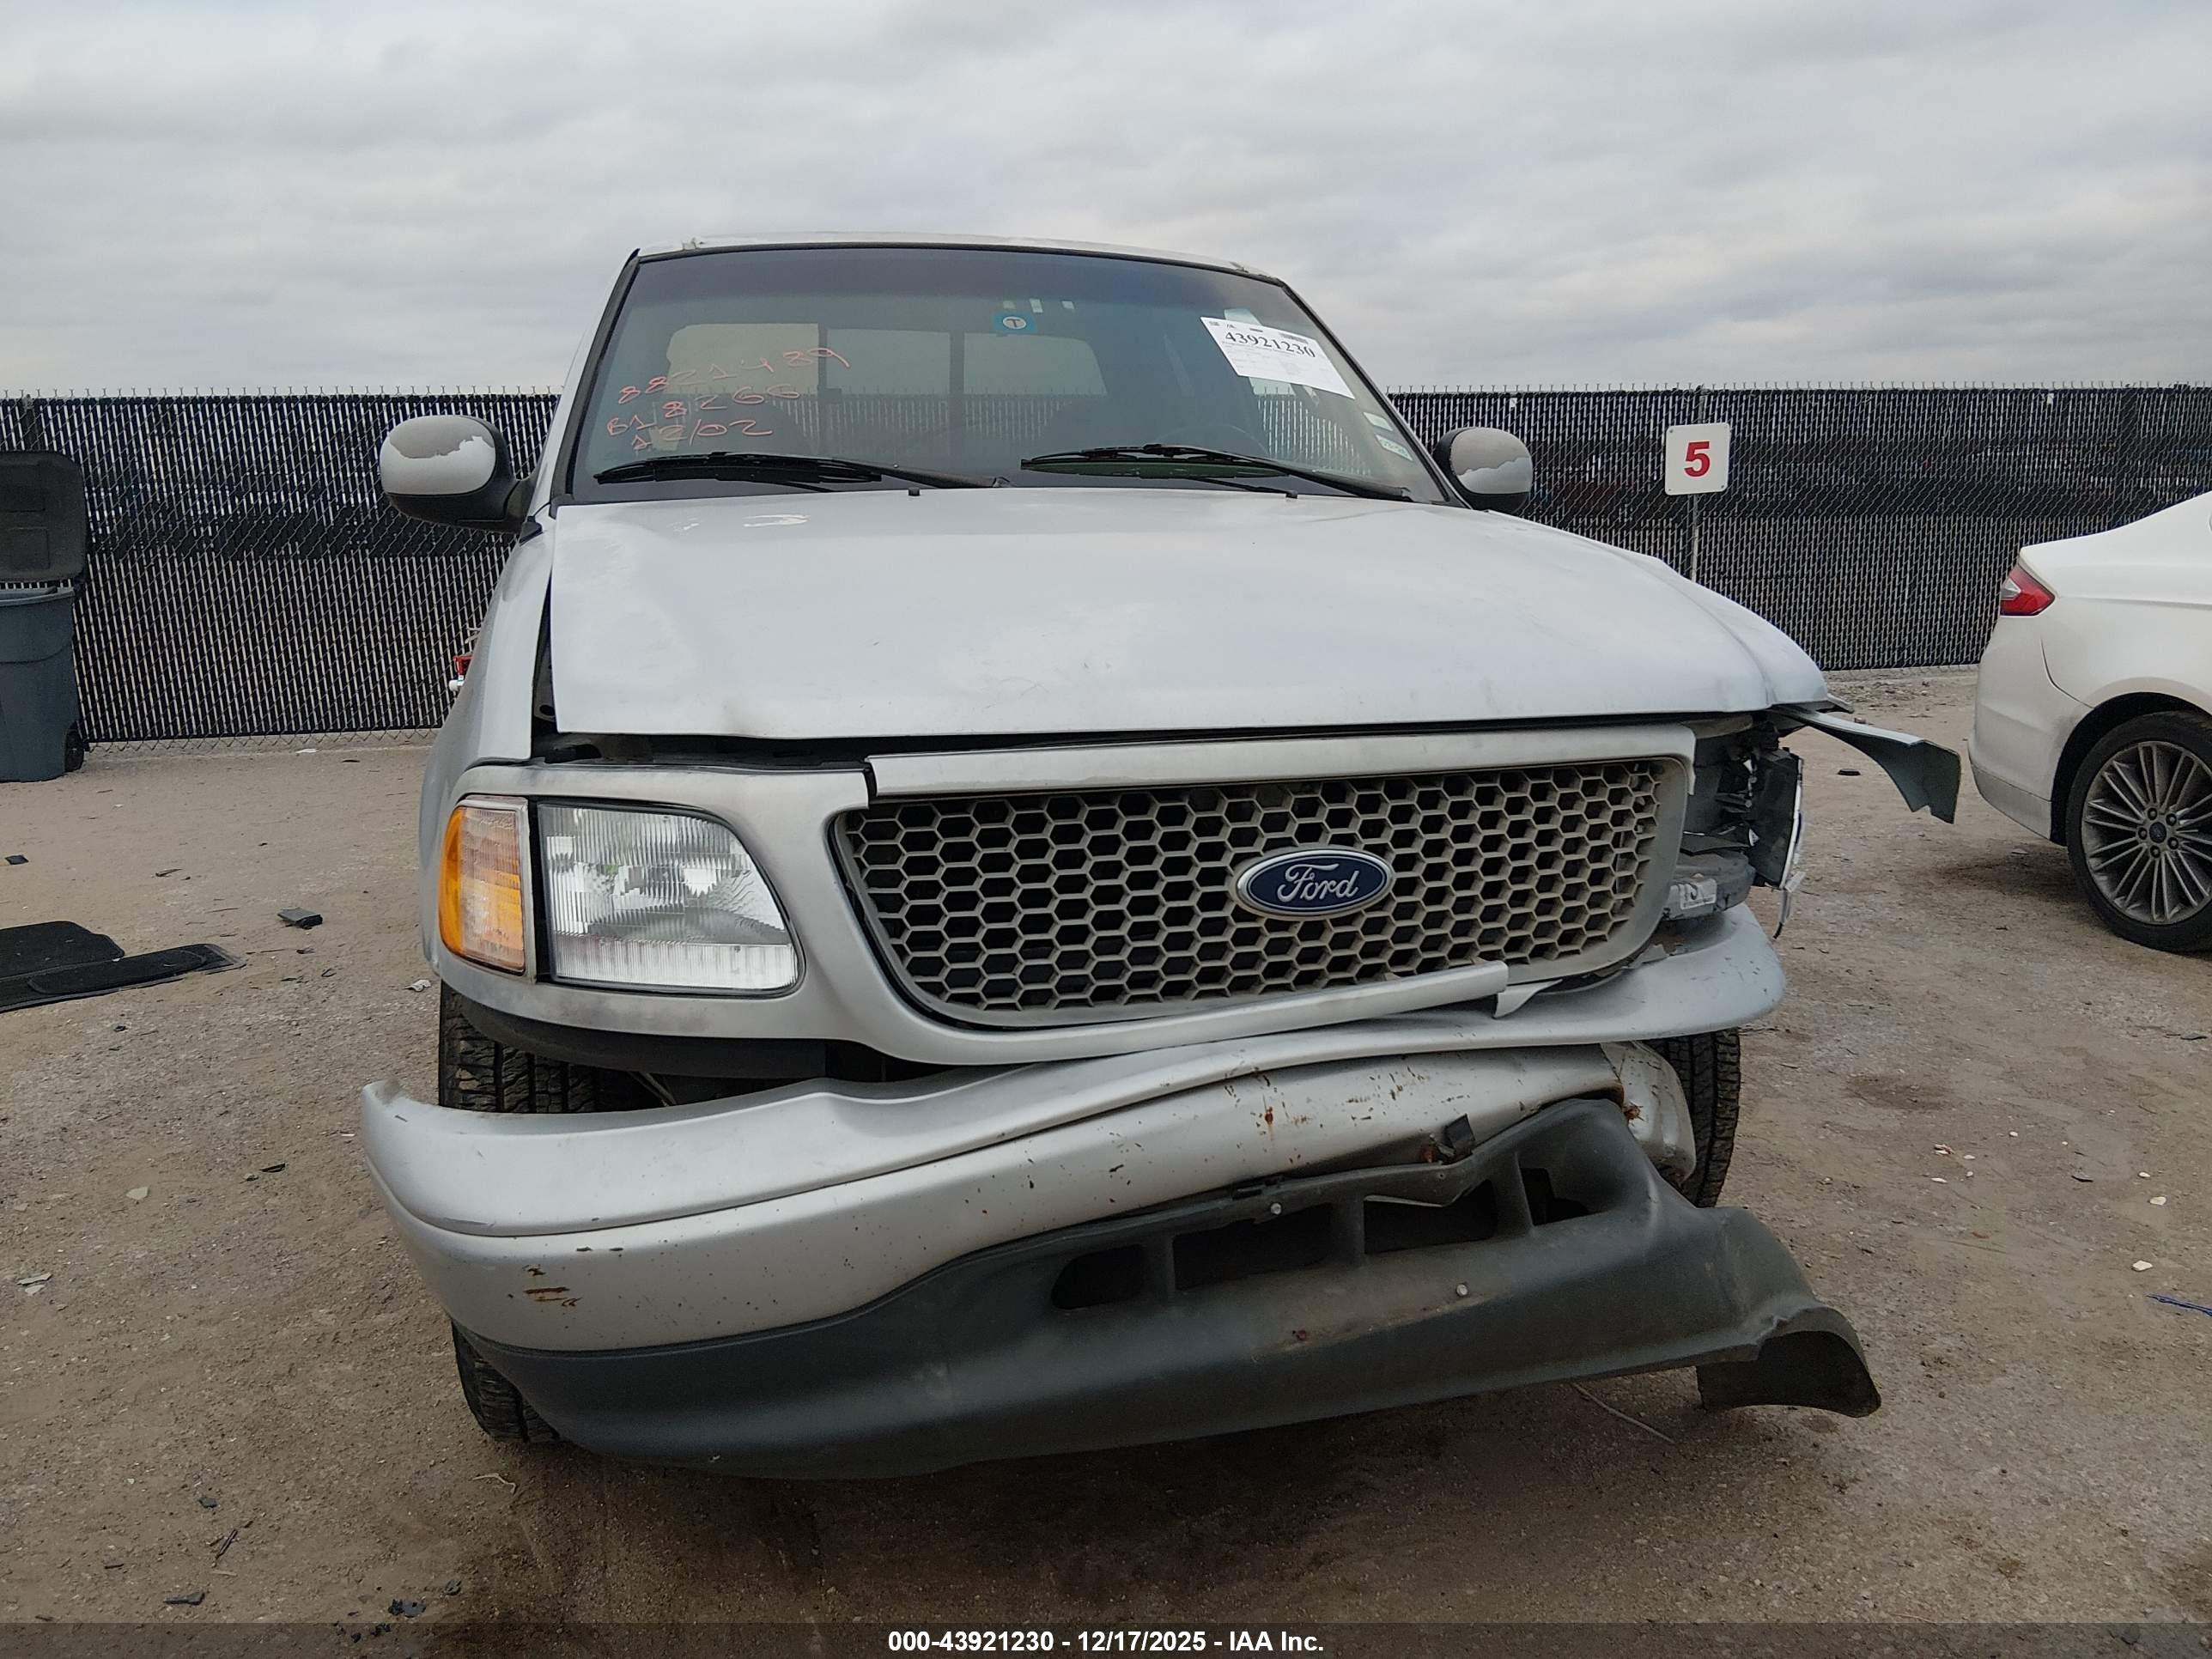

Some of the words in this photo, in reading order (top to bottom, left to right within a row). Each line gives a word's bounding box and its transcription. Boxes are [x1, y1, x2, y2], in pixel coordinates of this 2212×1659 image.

[1224, 331, 1316, 358] 43921230
[1683, 441, 1711, 477] 5
[1276, 862, 1360, 902] Ford
